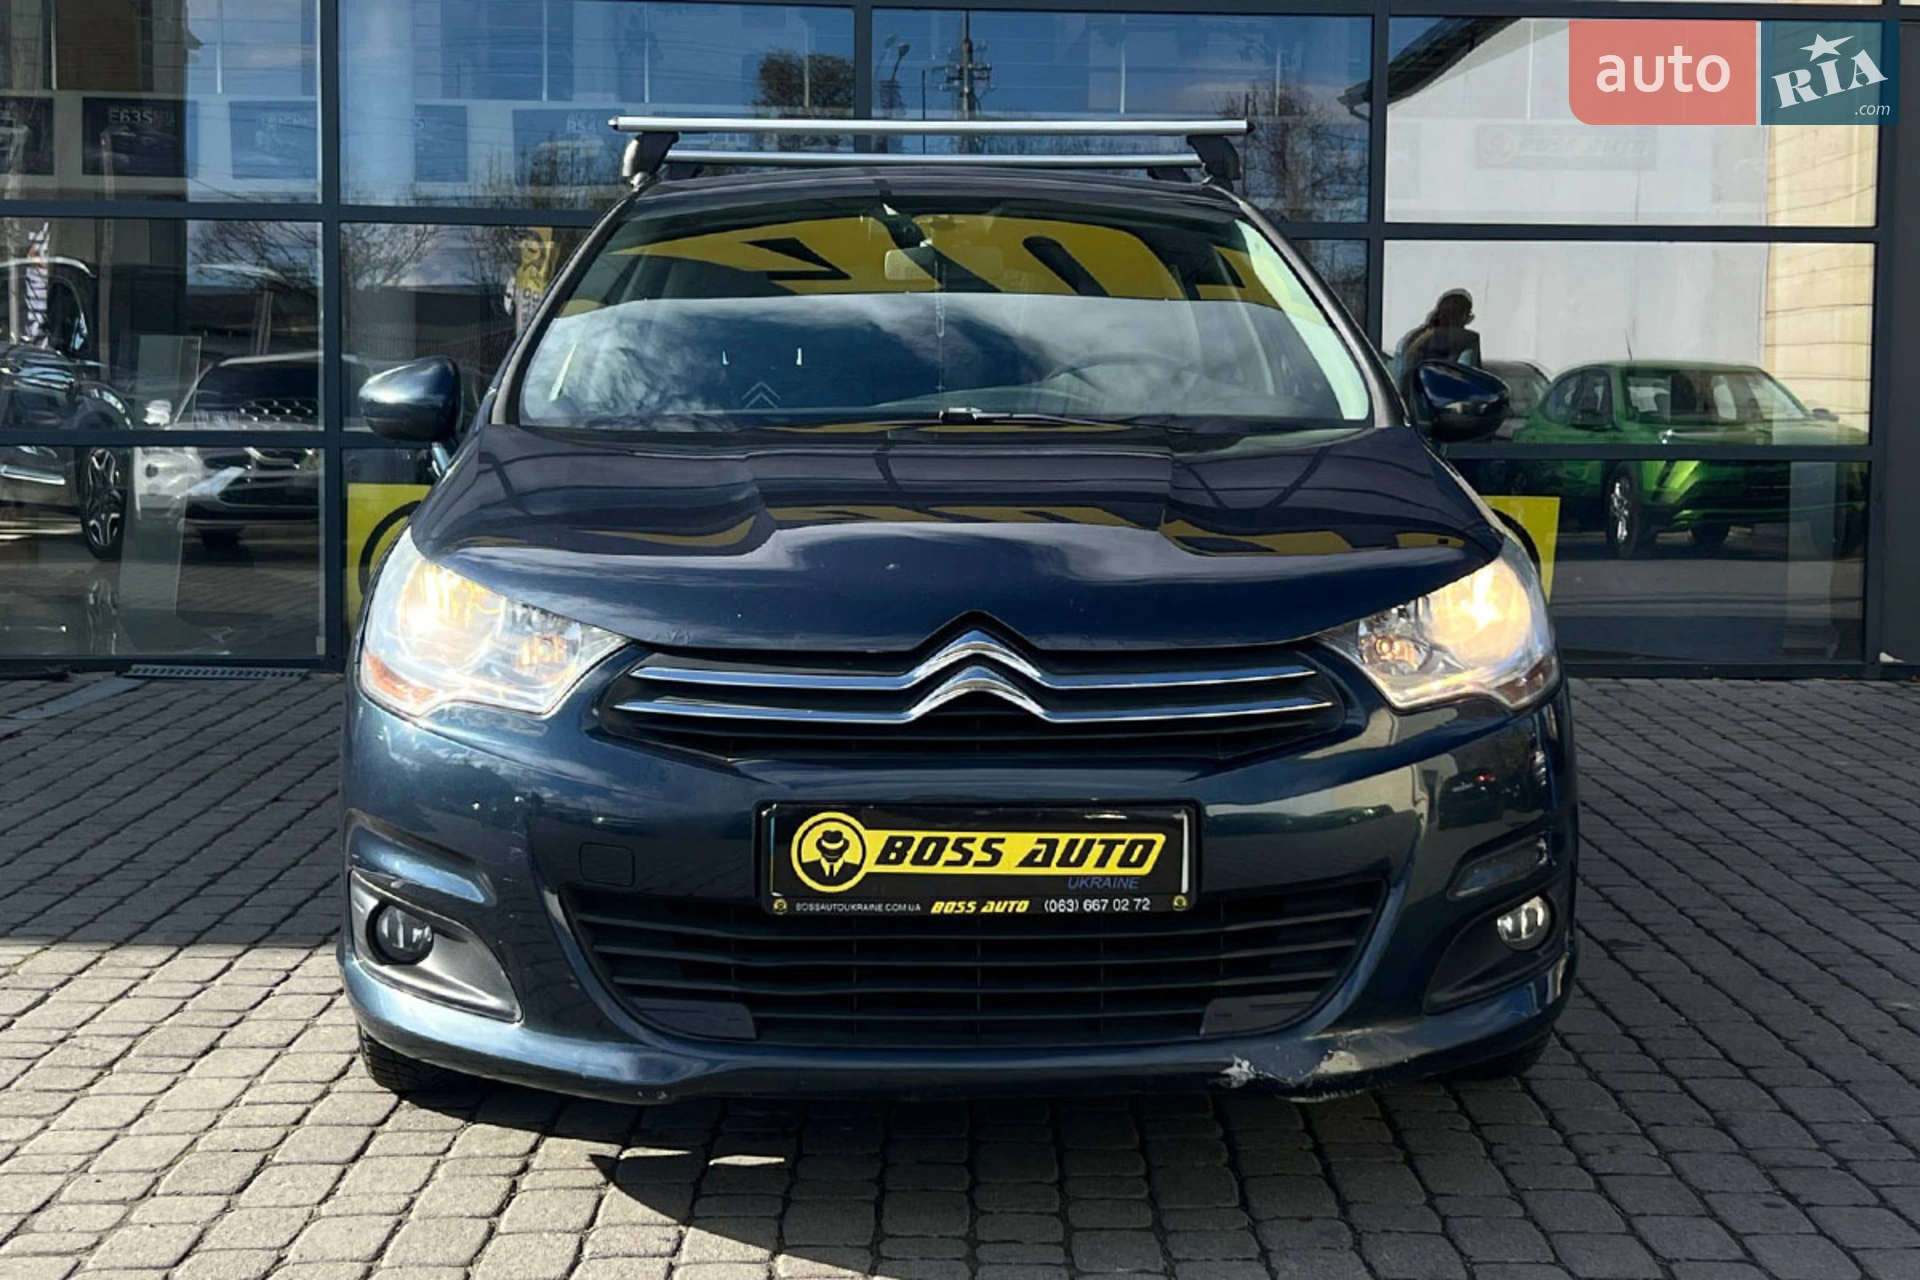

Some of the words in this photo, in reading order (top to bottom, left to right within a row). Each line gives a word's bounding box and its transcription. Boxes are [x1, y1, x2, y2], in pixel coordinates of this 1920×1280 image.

[875, 835, 1005, 867] BOSS
[1016, 838, 1157, 868] AUTO
[1068, 877, 1141, 890] UKRAINE
[931, 901, 977, 914] BOSS
[981, 900, 1029, 913] AUTO
[1044, 898, 1079, 913] (063)
[1083, 898, 1108, 911] 667
[1113, 898, 1129, 911] 02
[1133, 898, 1151, 911] 72
